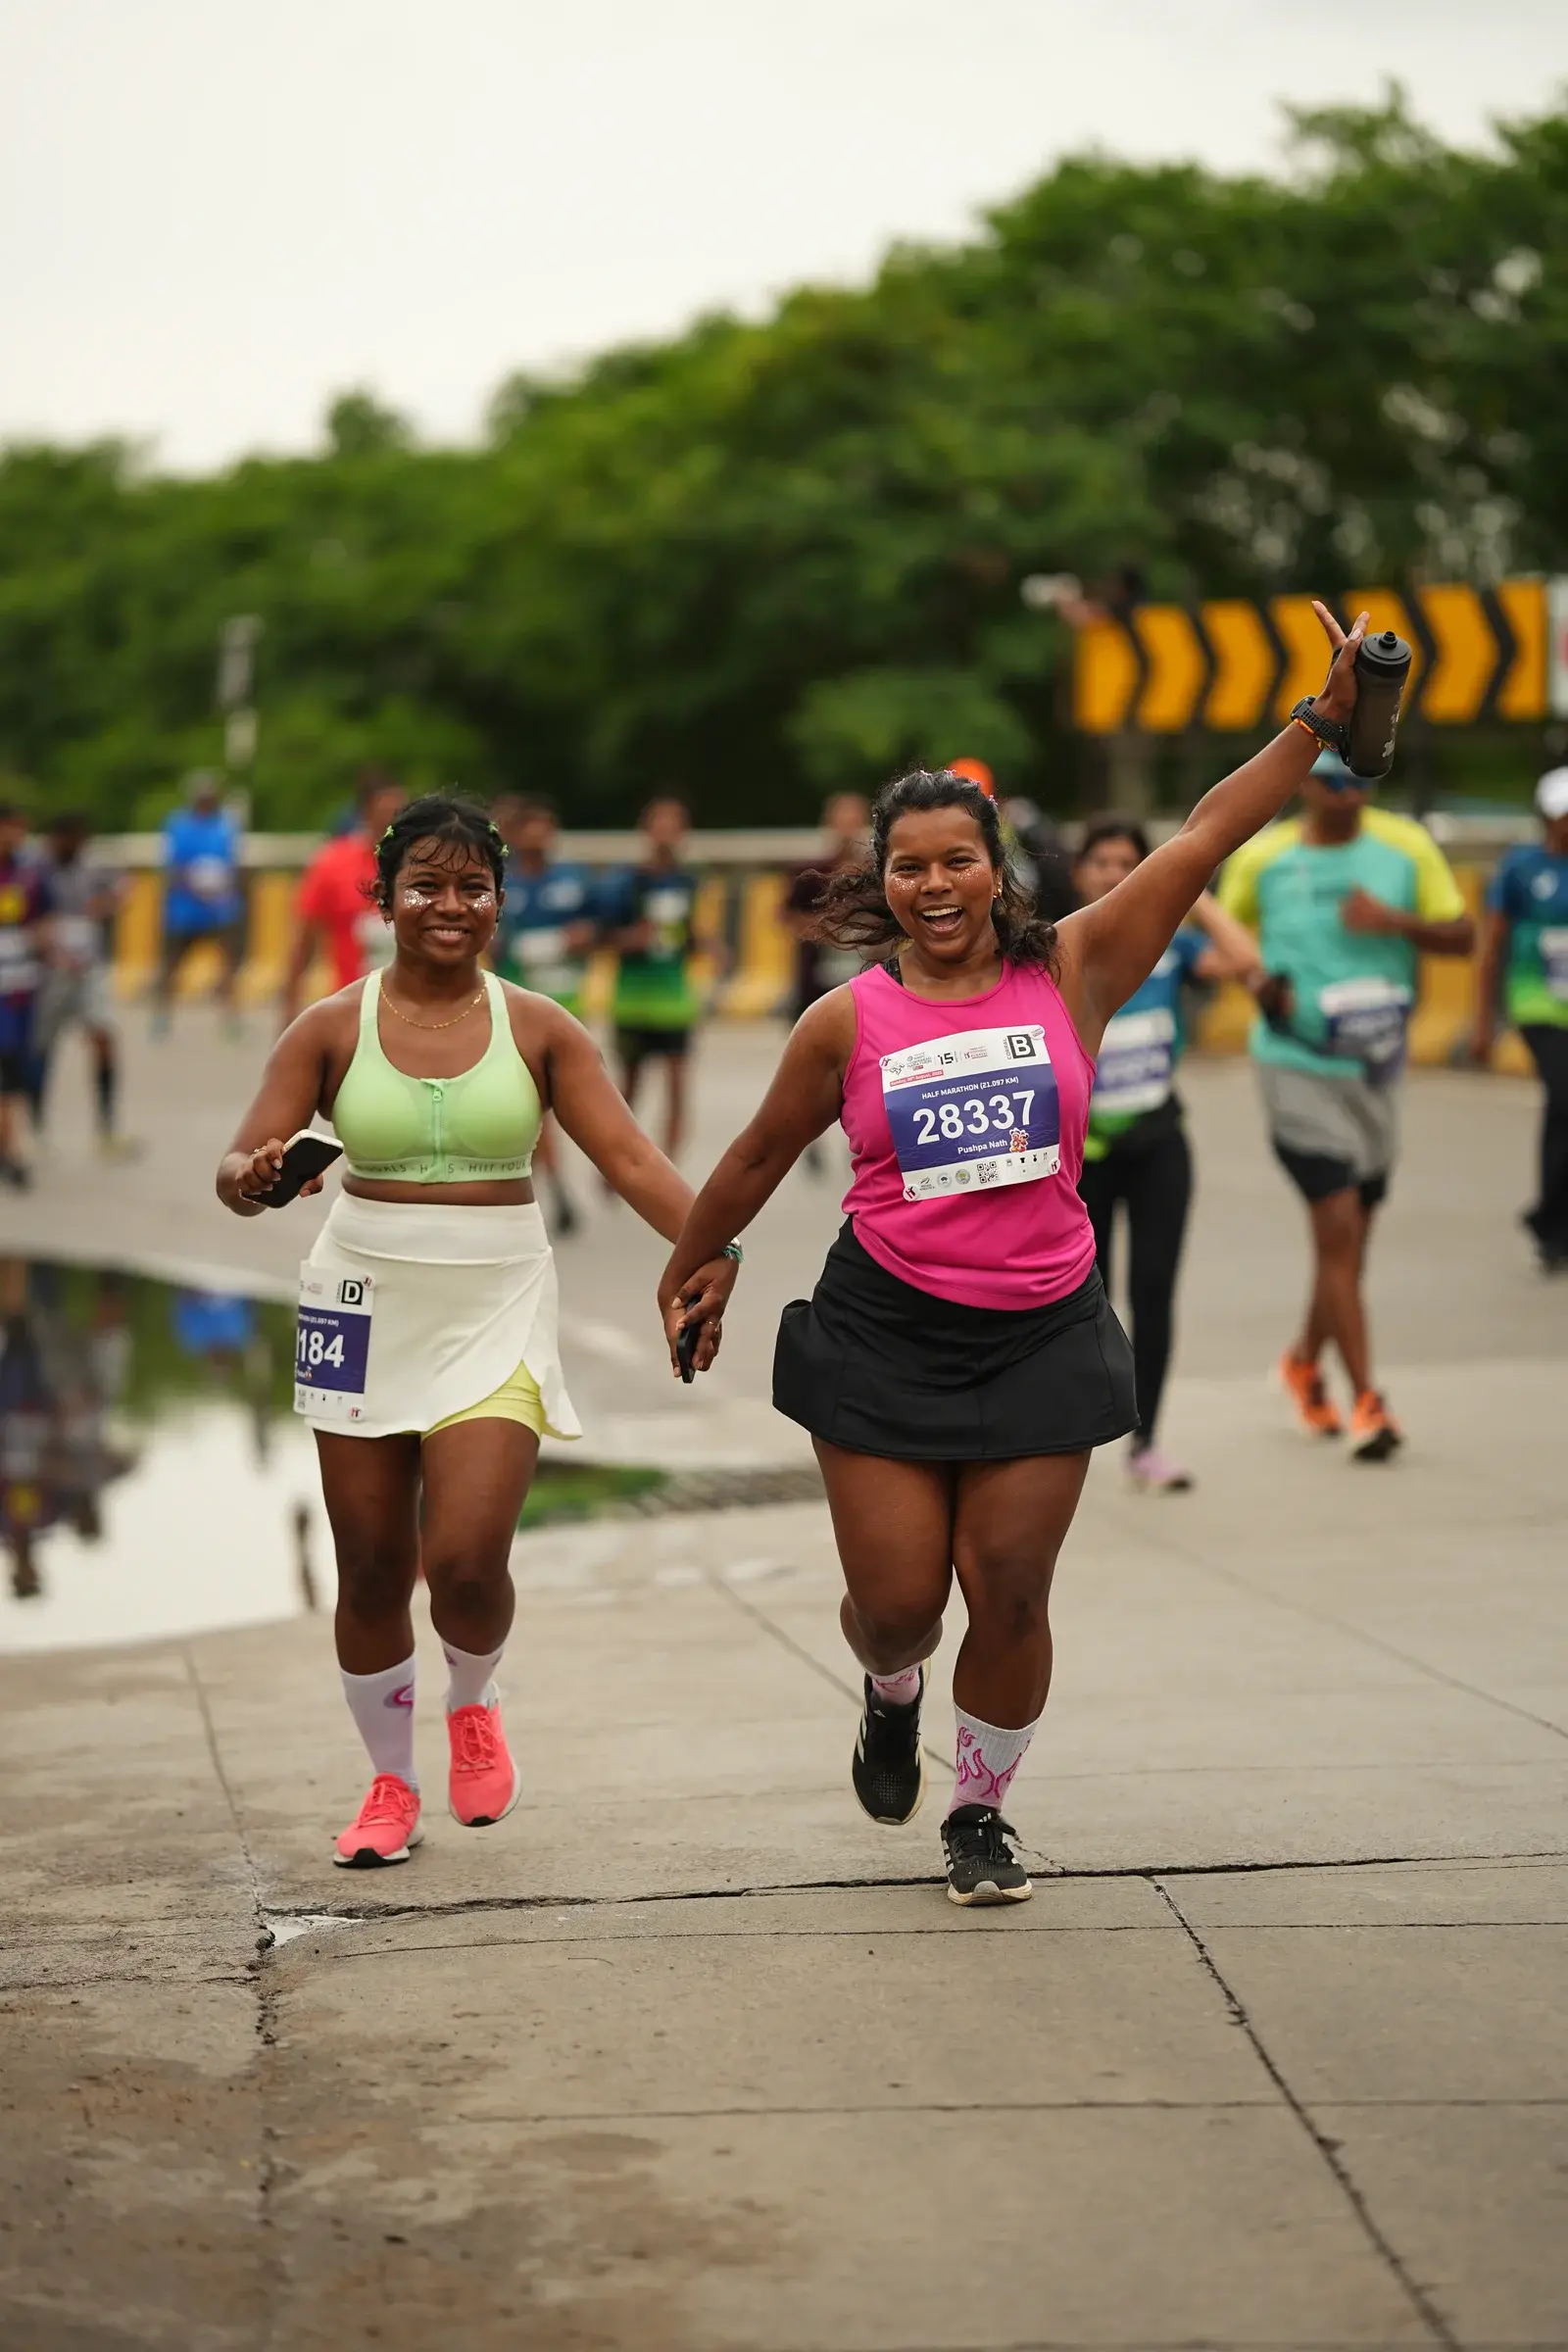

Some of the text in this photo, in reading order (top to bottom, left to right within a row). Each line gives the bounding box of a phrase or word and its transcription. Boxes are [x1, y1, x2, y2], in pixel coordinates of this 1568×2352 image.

[1010, 1036, 1032, 1056] B
[922, 1076, 1019, 1100] HALF MARATHON (21.097 KM)
[912, 1090, 1035, 1145] 28337
[957, 1140, 1007, 1154] Pushpa Nath
[343, 1281, 362, 1303] D
[296, 1327, 344, 1368] 184
